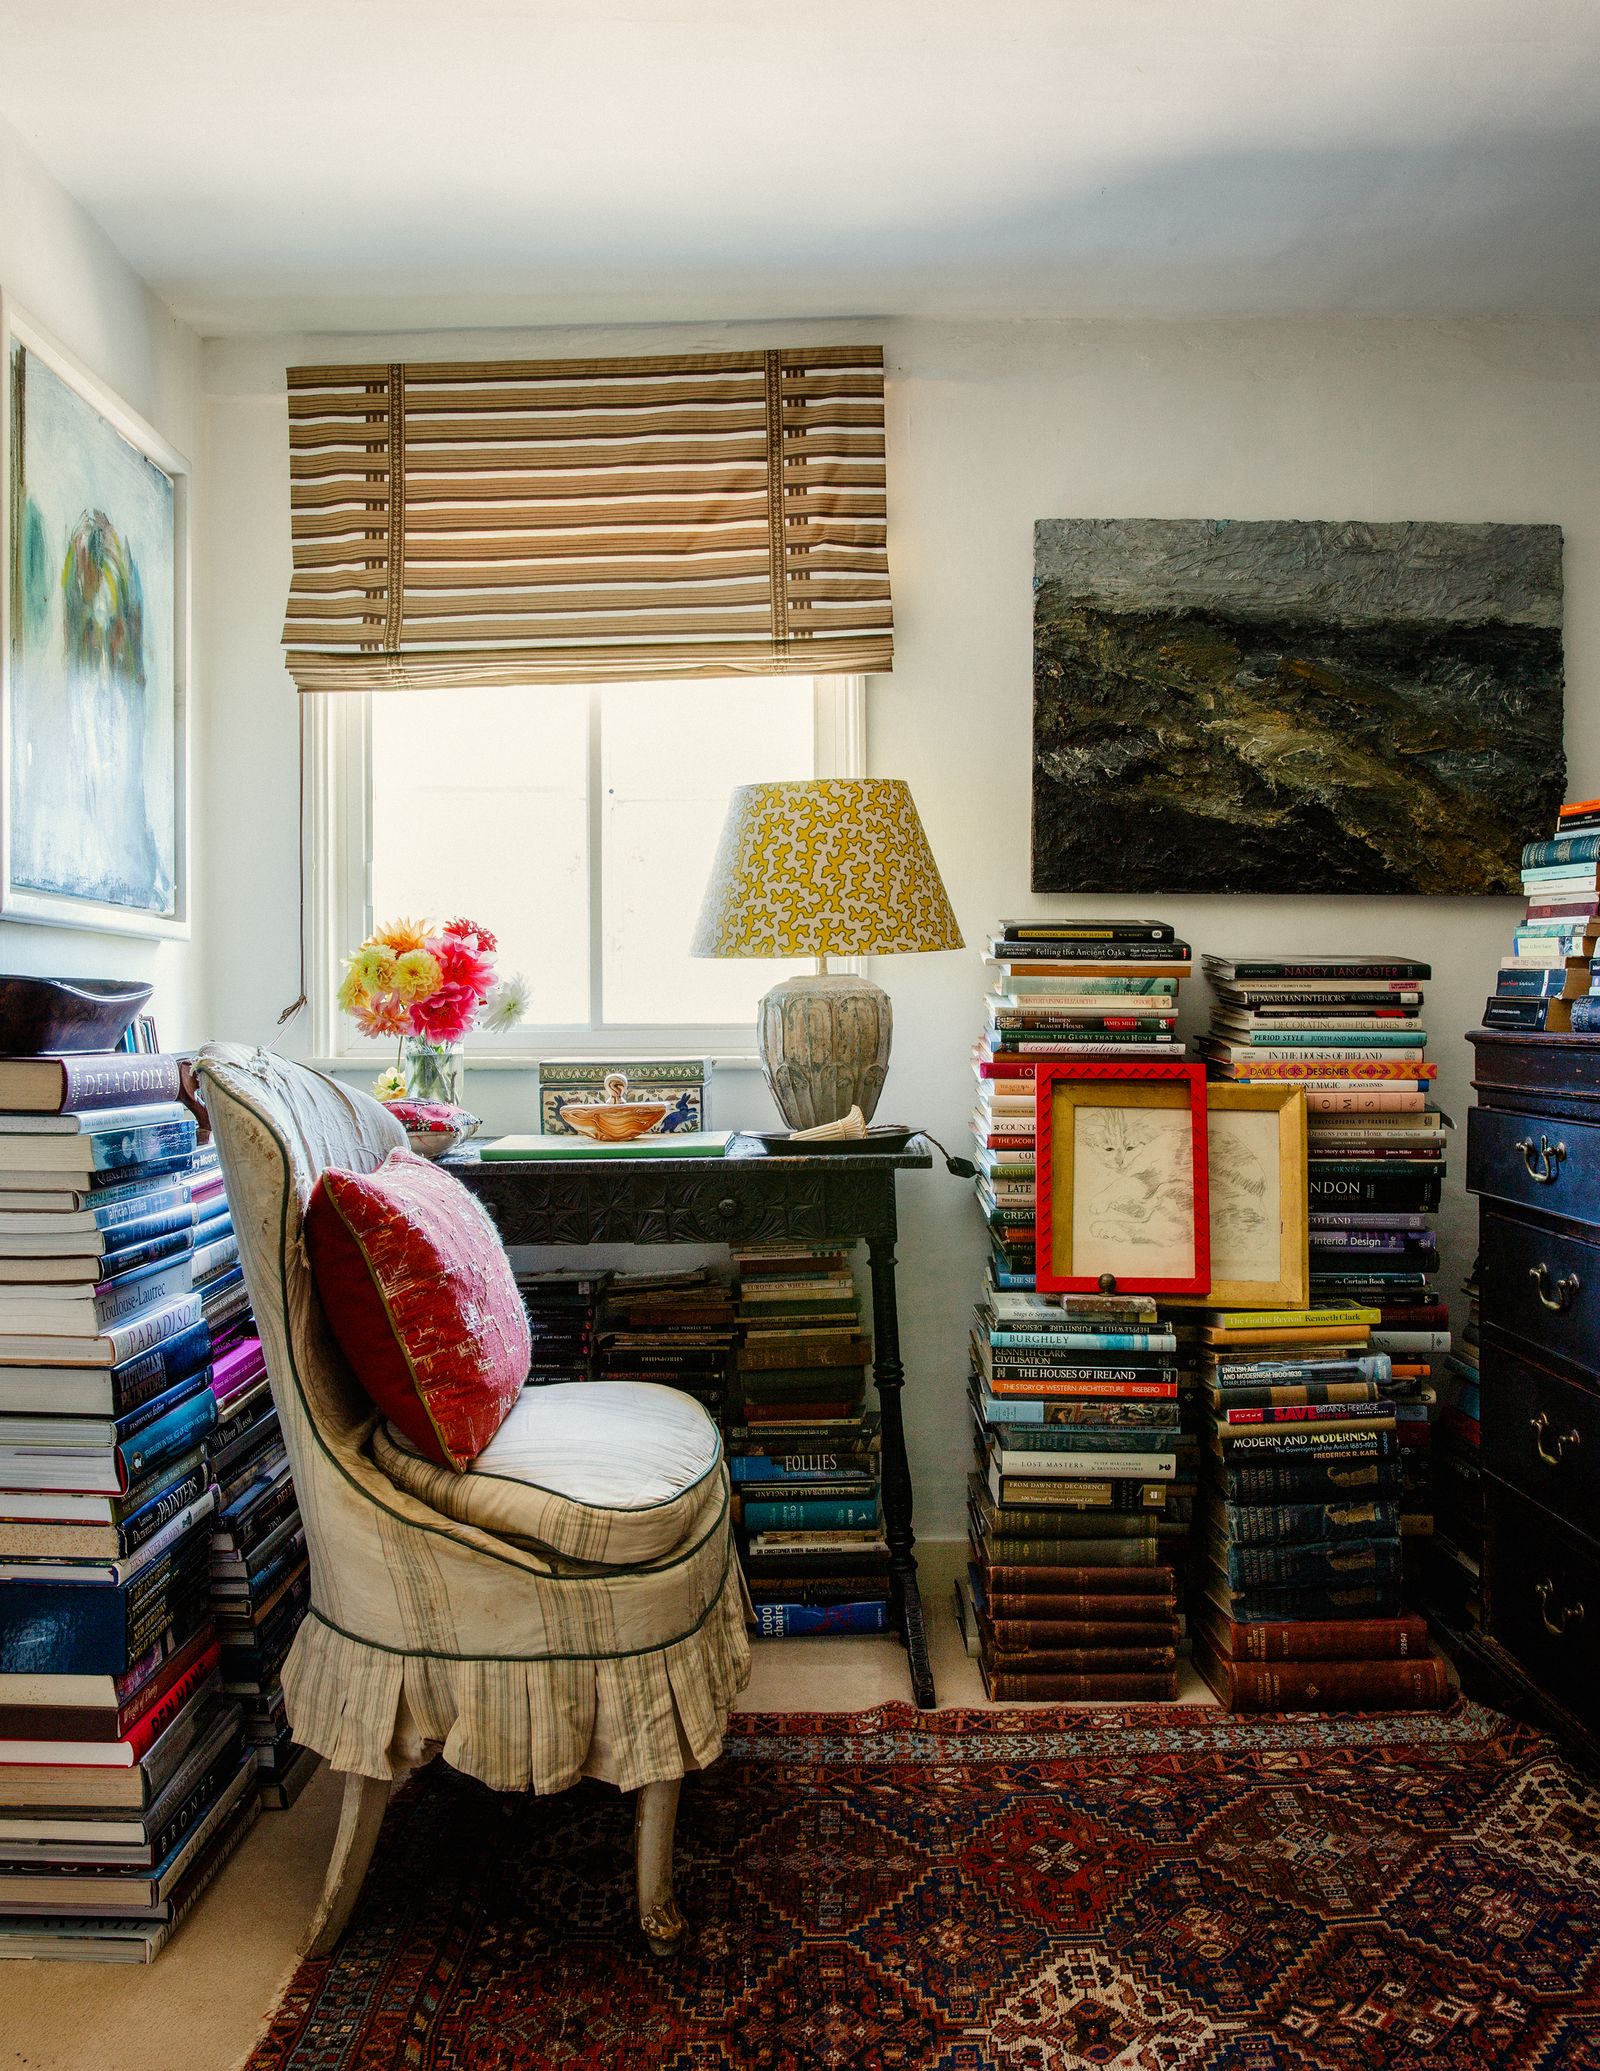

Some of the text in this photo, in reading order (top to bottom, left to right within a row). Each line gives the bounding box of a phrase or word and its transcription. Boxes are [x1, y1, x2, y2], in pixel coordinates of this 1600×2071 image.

[1036, 948, 1061, 958] Felling
[1284, 967, 1328, 976] NANCY
[1333, 967, 1398, 976] LANCASTER
[1274, 1021, 1400, 1029] DECORATING PICTURES
[1023, 1043, 1122, 1053] Eccentric Britain
[1269, 1052, 1278, 1060] IN
[1280, 1052, 1297, 1060] THE
[1300, 1052, 1331, 1060] HOUSES
[1345, 1052, 1382, 1060] IRELAND
[1250, 1068, 1276, 1076] DAVID
[1306, 1068, 1350, 1076] DESIGNER
[84, 1068, 164, 1097] DELACROIX
[1314, 1236, 1381, 1248] Interior Design
[100, 1282, 166, 1322] Toulouse-Lautrec
[128, 1304, 191, 1354] PARADISO
[1009, 1334, 1069, 1344] BURGHLEY
[995, 1348, 1066, 1358] KENNETH CLARK
[994, 1356, 1051, 1364] CIVILISATION
[118, 1352, 164, 1391] VICTORIAN
[1018, 1368, 1136, 1380] THE HOUSES OF IRELAND
[1274, 1407, 1317, 1421] SAVE
[1316, 1402, 1379, 1414] BRITAIN'S HERITAGE
[218, 1409, 253, 1446] Oliver Messel
[1233, 1432, 1377, 1448] MODERN AND MODERNISM
[785, 1454, 837, 1472] FOLLIES
[158, 1476, 198, 1522] PAINTERS
[762, 1607, 772, 1636] 1000
[773, 1604, 784, 1638] chairs
